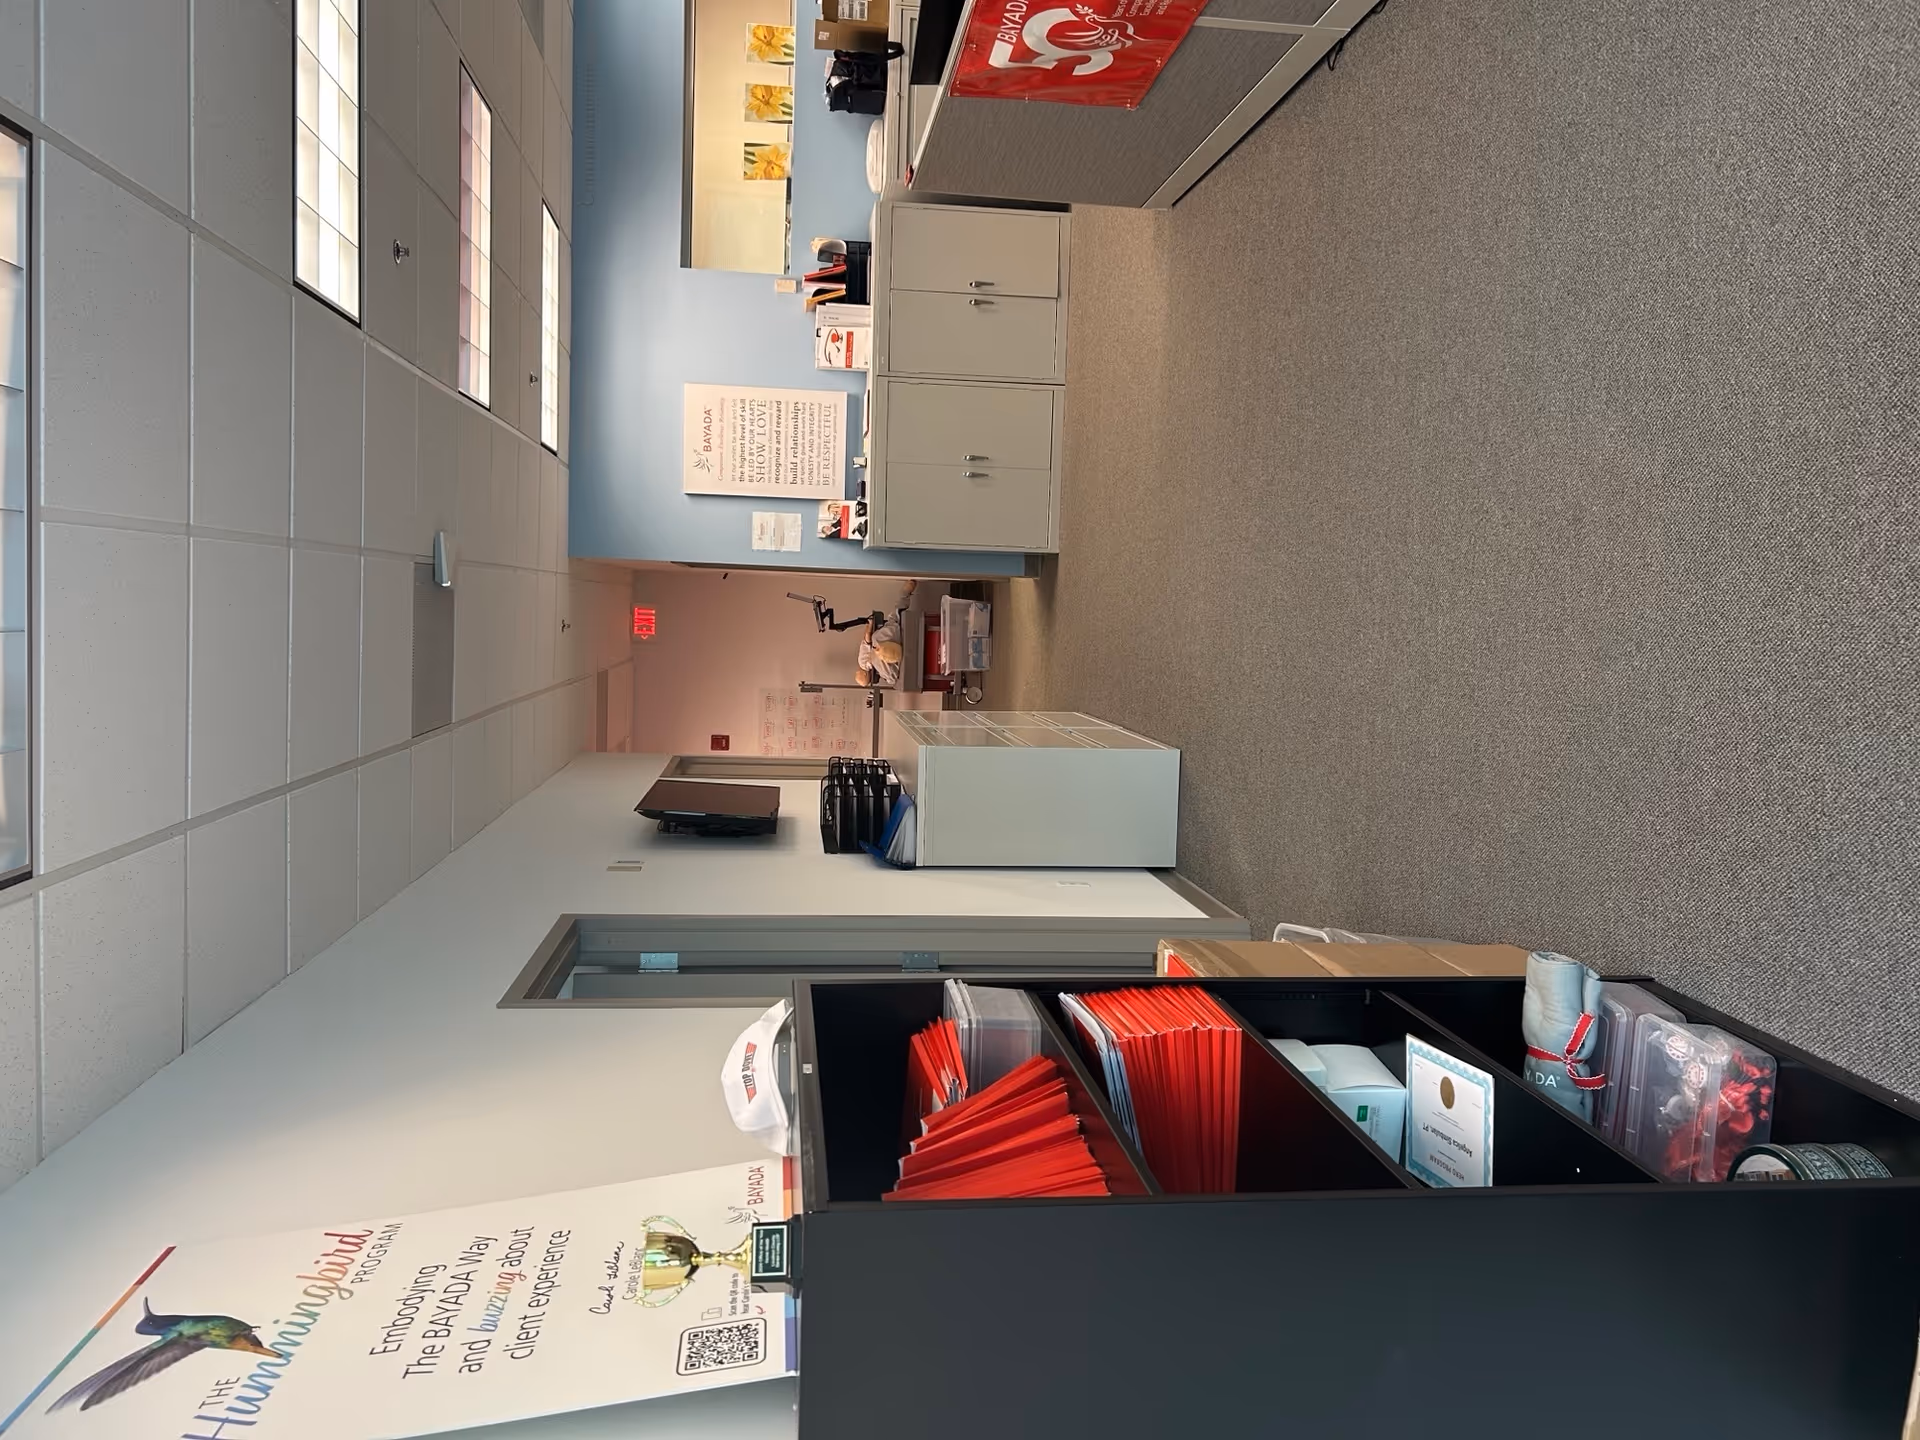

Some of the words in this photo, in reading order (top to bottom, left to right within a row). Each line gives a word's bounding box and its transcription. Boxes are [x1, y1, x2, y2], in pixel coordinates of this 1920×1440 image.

[996, 0, 1028, 43] BAYAD
[988, 7, 1122, 76] 50
[702, 408, 712, 452] BAYADA
[740, 414, 746, 422] of
[756, 400, 766, 436] LOVE
[790, 402, 801, 458] relationships
[739, 442, 747, 468] highest
[748, 446, 755, 457] BY
[822, 404, 831, 470] RESPECTFUL
[748, 474, 754, 482] BE
[756, 441, 766, 483] SHOW
[773, 447, 782, 484] recognize
[790, 462, 798, 485] build
[822, 474, 830, 486] BE
[634, 606, 656, 636] EXIT
[742, 1054, 752, 1072] DOVE
[742, 1074, 753, 1088] TOP
[1524, 1070, 1557, 1089] YDA
[1430, 1154, 1452, 1172] PROGRAM
[747, 1166, 765, 1206] BAYADA
[350, 1222, 404, 1284] PROGRAM
[456, 1235, 498, 1266] Way
[496, 1226, 534, 1268] about
[422, 1270, 479, 1338] BAYADA
[466, 1270, 528, 1332] buzzing
[502, 1311, 546, 1360] client
[527, 1229, 571, 1308] experience
[622, 1275, 640, 1300] Carole
[368, 1264, 447, 1355] Embodying
[728, 1305, 737, 1316] Scan
[180, 1229, 374, 1440] Hummingbird
[402, 1344, 445, 1379] The
[458, 1338, 492, 1374] and
[198, 1376, 240, 1409] THE
